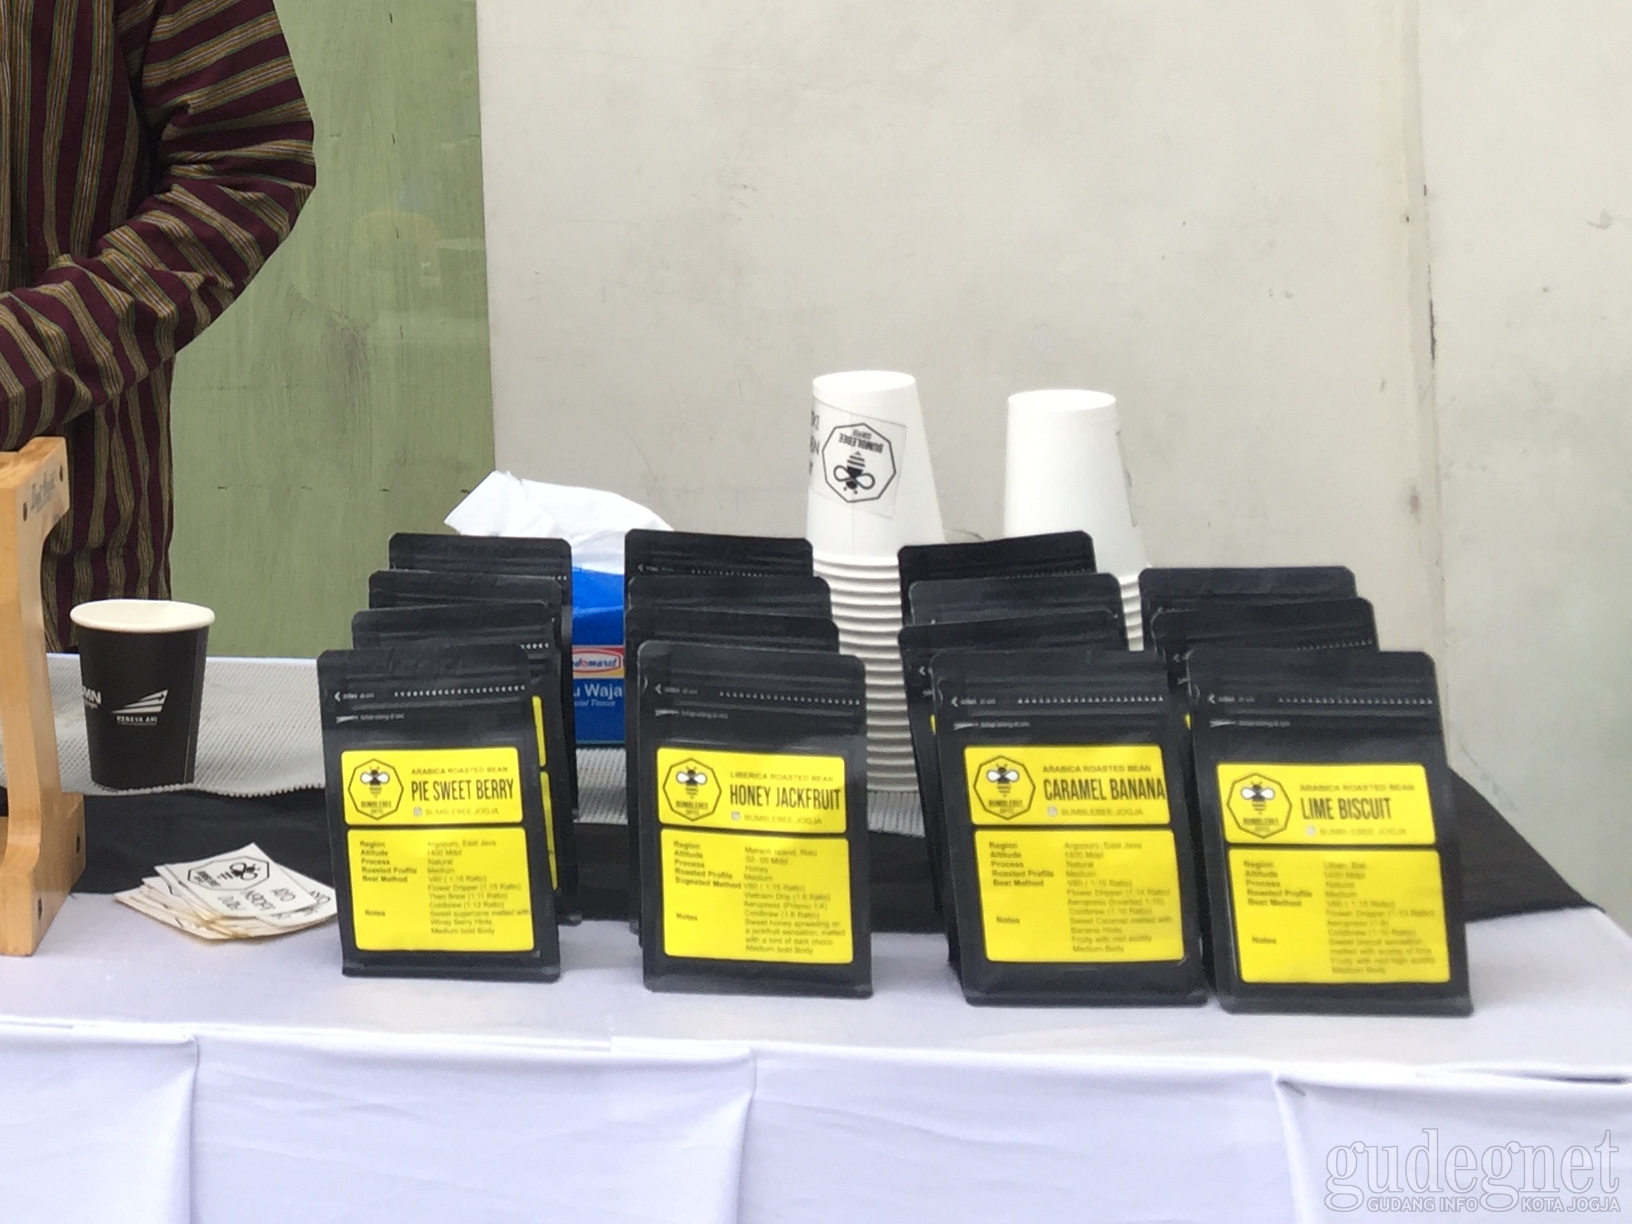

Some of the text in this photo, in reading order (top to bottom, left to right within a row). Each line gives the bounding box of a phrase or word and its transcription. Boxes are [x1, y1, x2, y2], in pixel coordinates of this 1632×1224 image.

[584, 683, 623, 700] Waja
[770, 773, 809, 781] ROASTED
[1043, 765, 1081, 773] ARABICA
[411, 778, 514, 801] PIE SWEET BERRY
[730, 784, 841, 810] HONEY JACKFRUIT
[1043, 778, 1166, 800] CARAMEL BANANA
[1300, 797, 1391, 819] LIME BISCUIT
